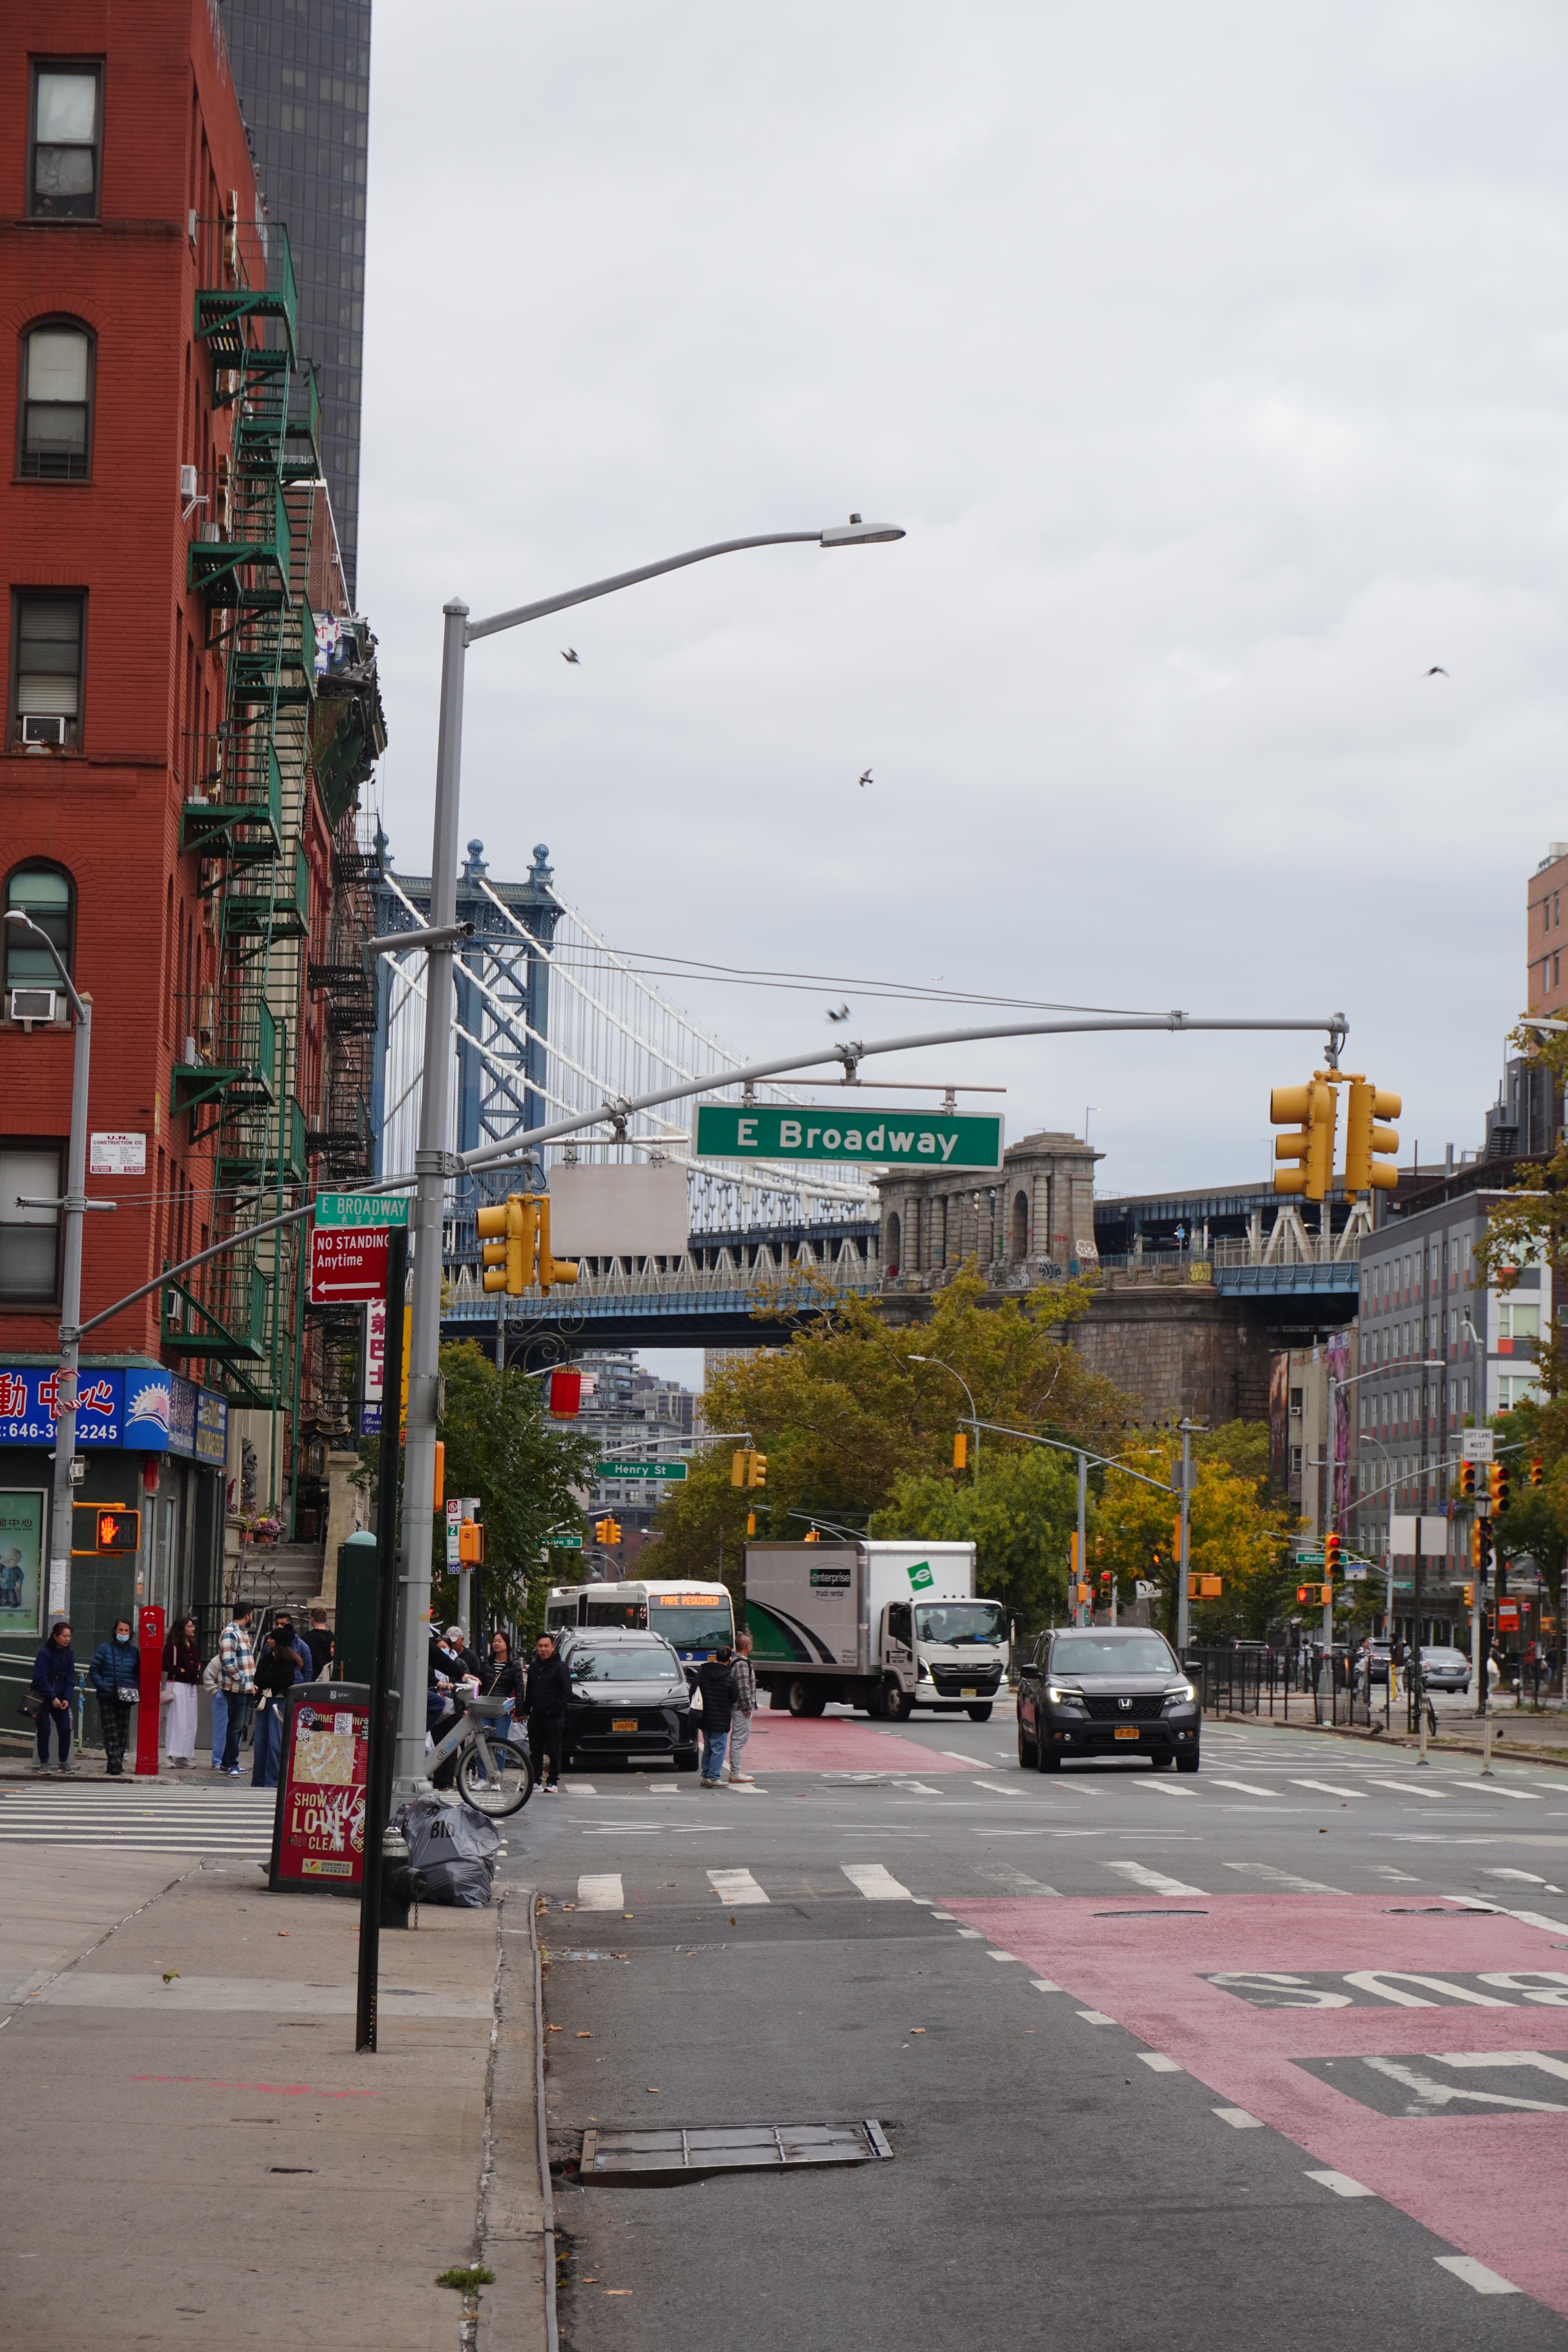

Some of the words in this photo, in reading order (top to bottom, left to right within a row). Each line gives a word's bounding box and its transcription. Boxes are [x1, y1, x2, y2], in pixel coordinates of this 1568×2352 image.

[737, 1118, 759, 1147] E
[780, 1120, 959, 1161] Broadway
[322, 1197, 329, 1214] E
[337, 1197, 406, 1217] BROADWAY
[317, 1237, 333, 1250] NO
[336, 1234, 389, 1250] STANDING
[317, 1253, 363, 1270] Anytime
[369, 1301, 386, 1385] 弟巴士
[363, 1417, 381, 1425] Bea
[365, 1426, 381, 1434] Cen
[615, 1464, 648, 1476] Henry
[655, 1466, 666, 1475] St
[450, 1526, 456, 1535] 2
[811, 1572, 850, 1585] enterprise
[815, 1588, 828, 1597] truck
[830, 1588, 844, 1597] rental
[660, 1596, 679, 1606] FARE
[682, 1596, 719, 1606] REQUIRED
[437, 1749, 447, 1760] citi
[294, 1793, 327, 1808] SHOW
[328, 1797, 345, 1807] SOM
[292, 1808, 345, 1836] LOVE
[430, 1820, 456, 1840] BID
[308, 1836, 345, 1852] CLEAN
